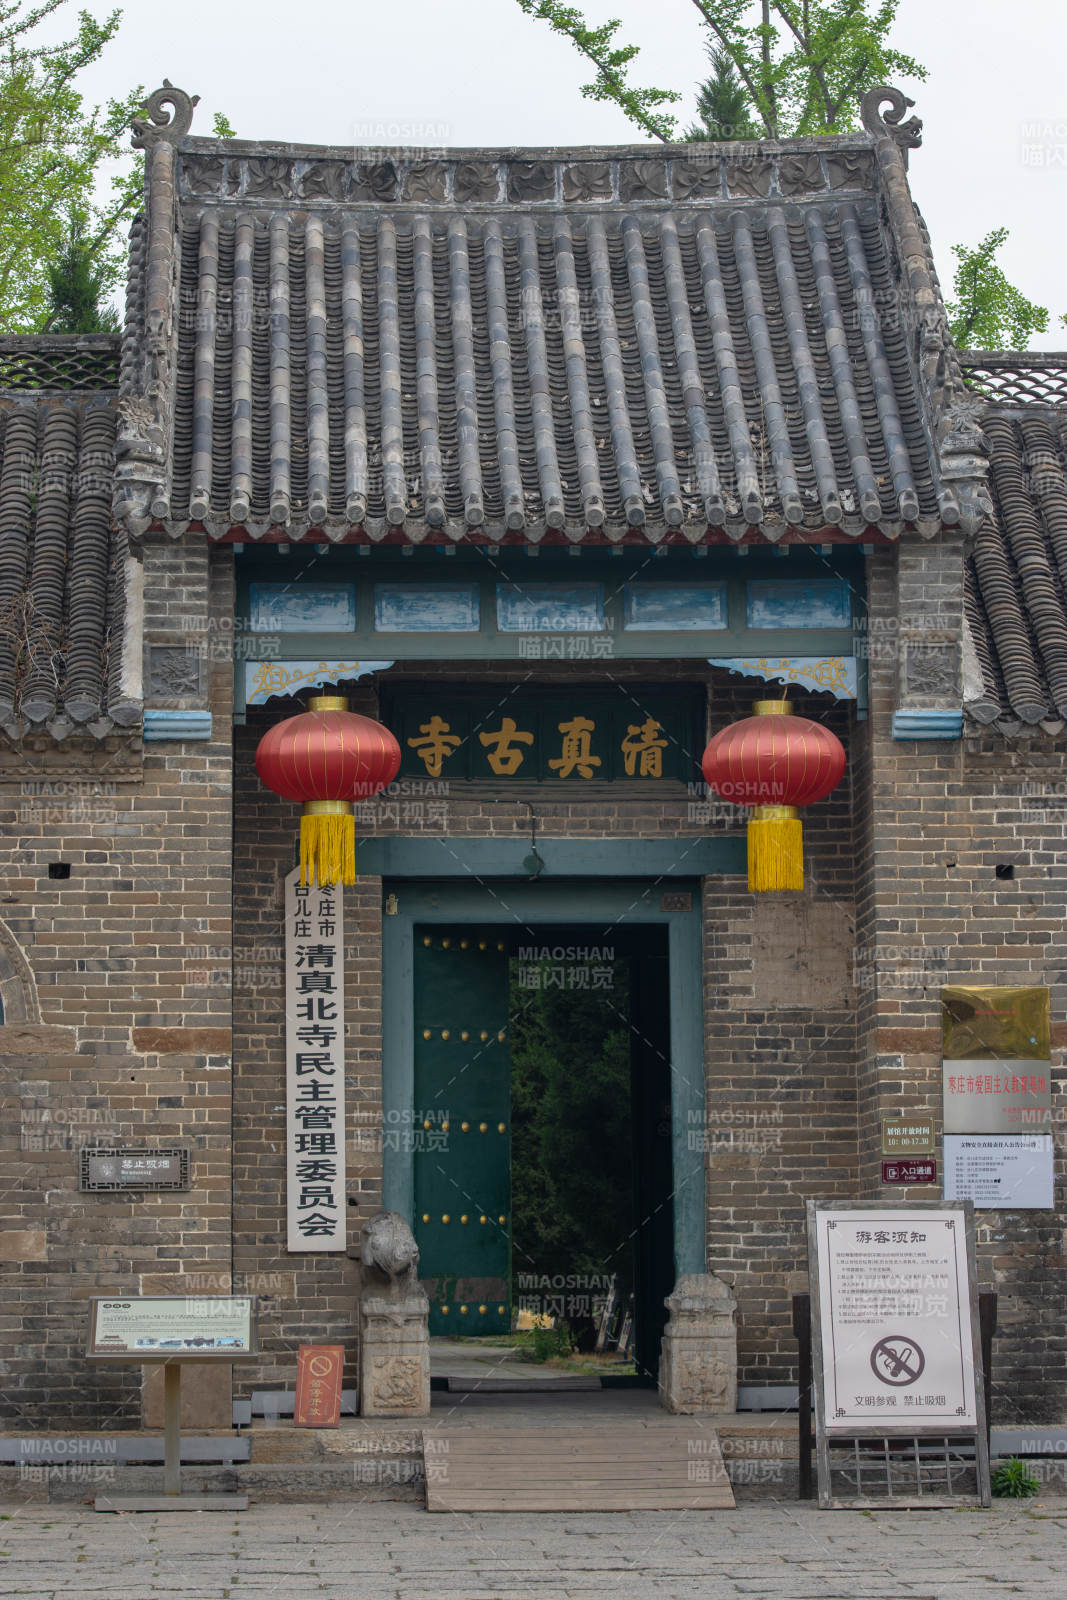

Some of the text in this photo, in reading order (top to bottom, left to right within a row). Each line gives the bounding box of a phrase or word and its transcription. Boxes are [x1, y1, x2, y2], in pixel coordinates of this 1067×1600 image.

[948, 1074, 1048, 1095] 枣庄市爱国主义教育基地
[294, 944, 339, 1238] 清真北寺民主管理委员会
[121, 1159, 170, 1169] 禁止吸烟
[901, 1166, 932, 1175] 入口通道
[856, 1231, 927, 1244] 游客须知
[855, 1395, 947, 1407] 文明参观 禁止吸烟
